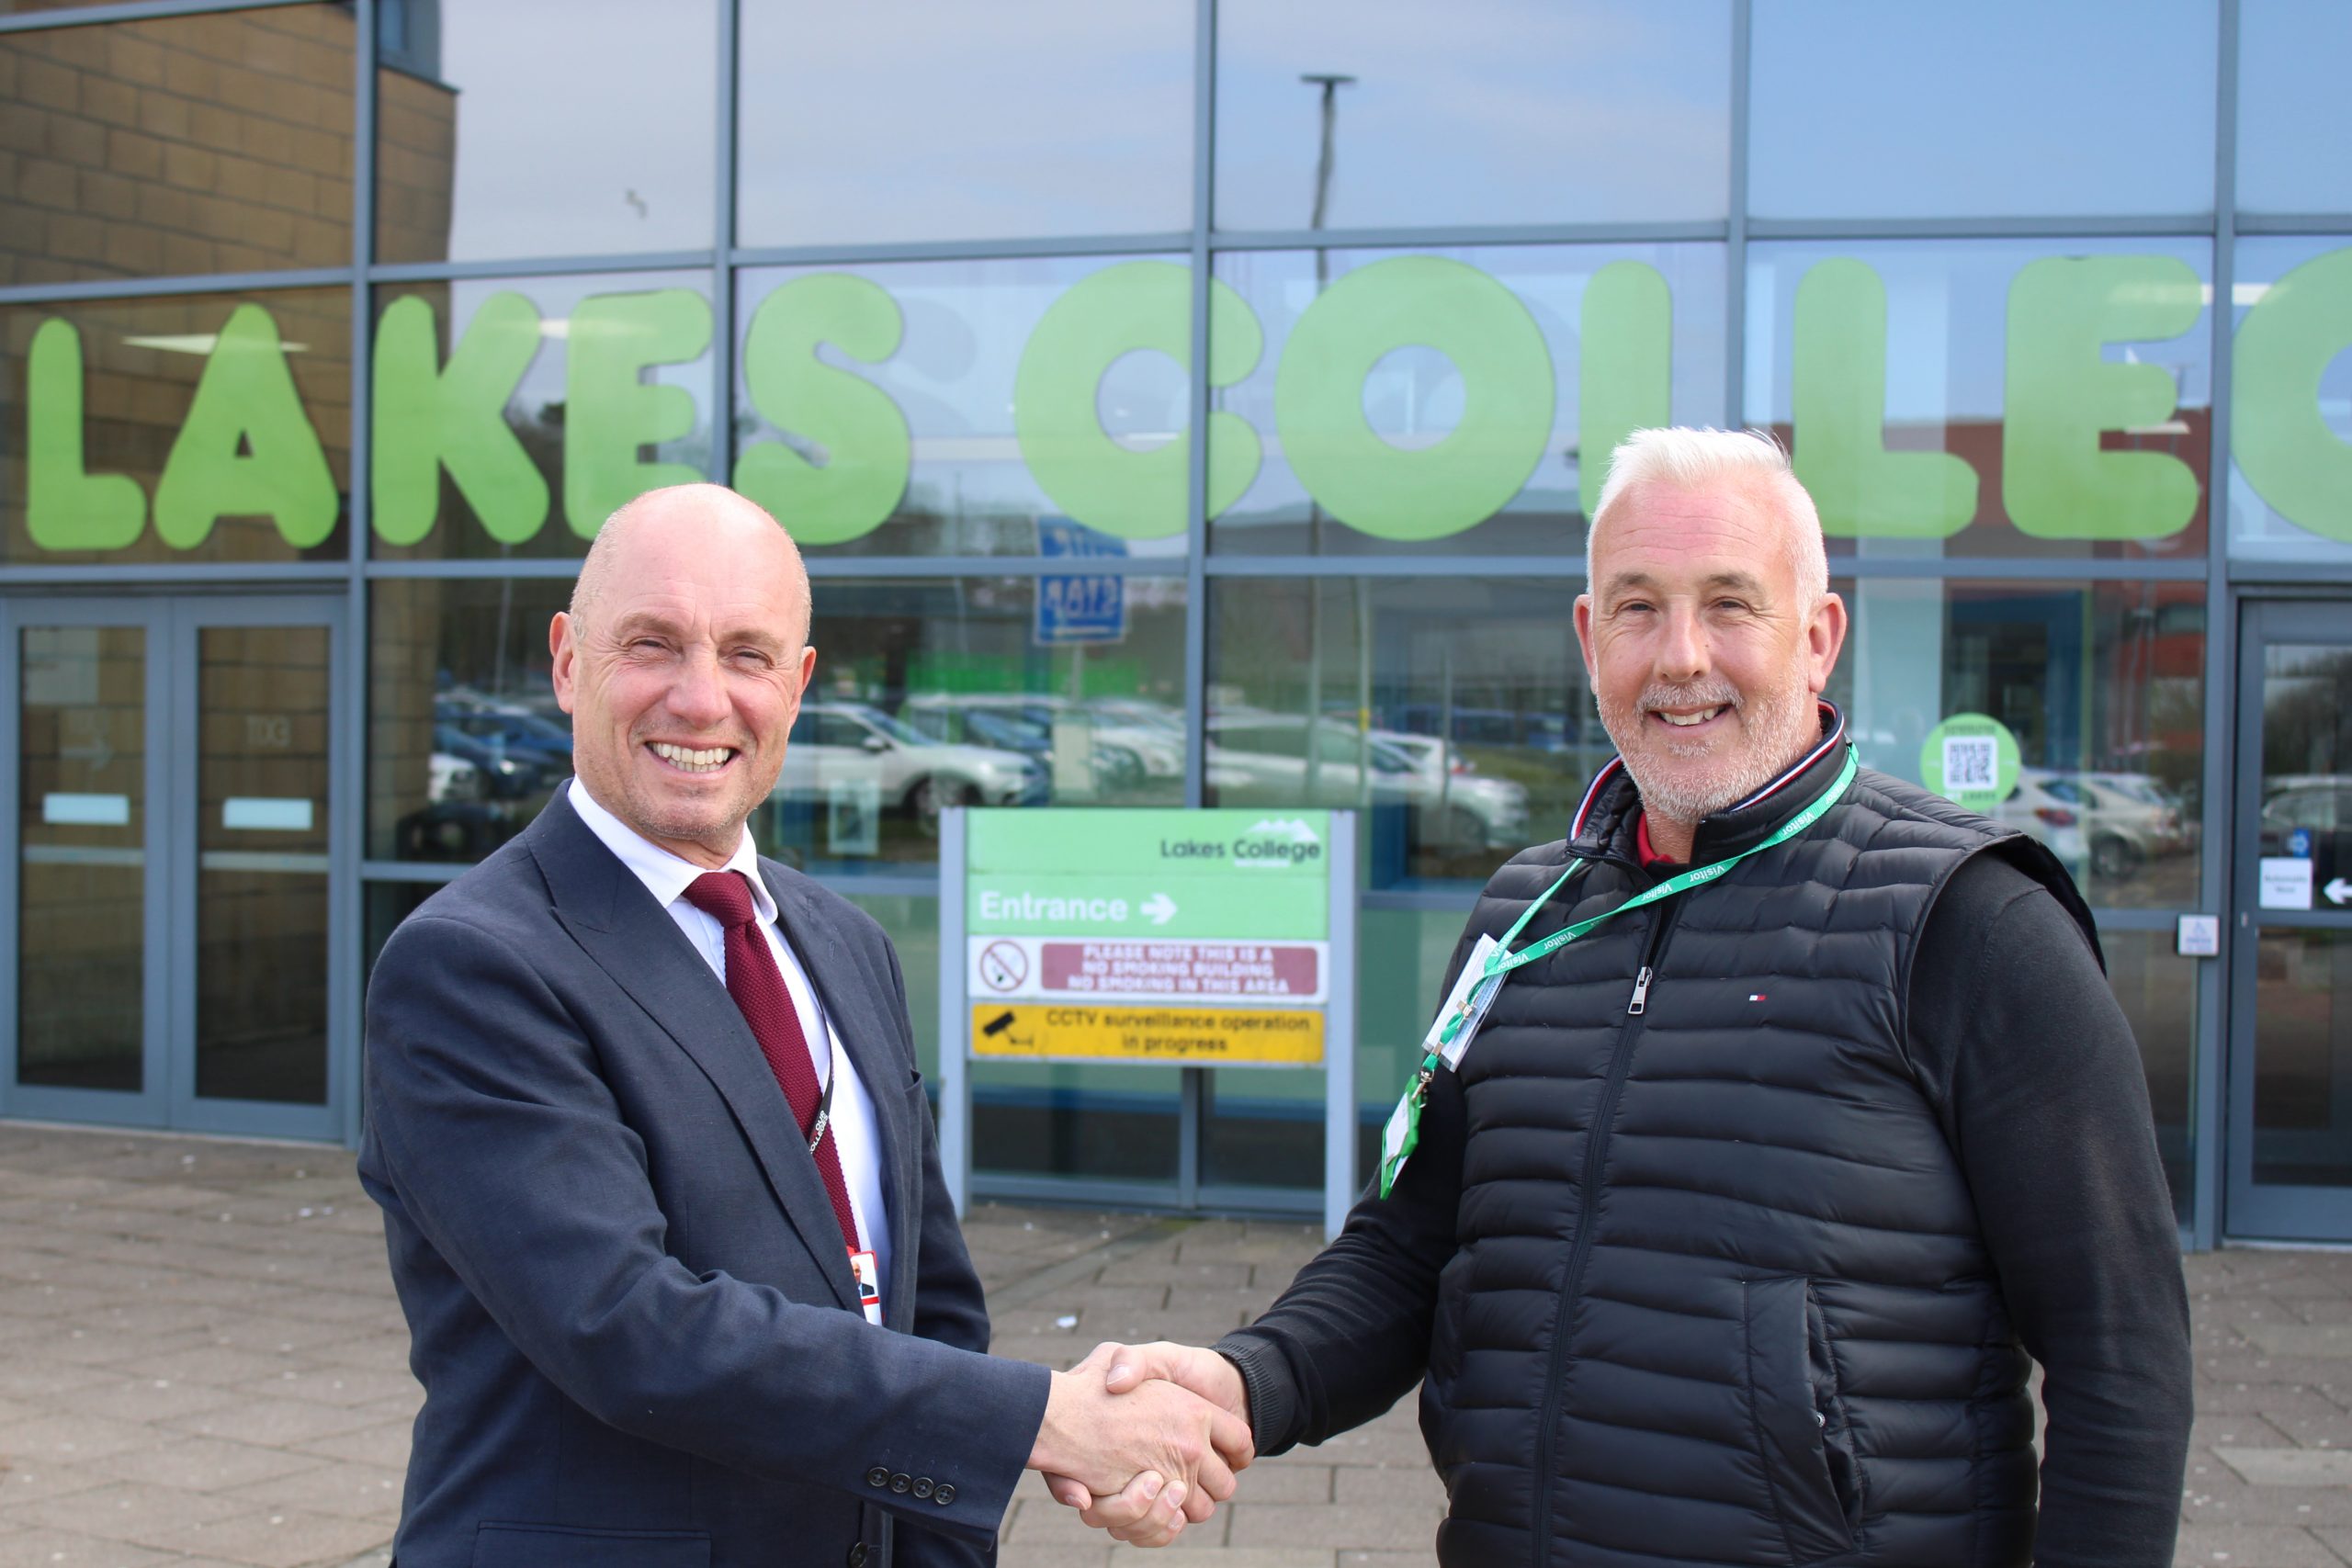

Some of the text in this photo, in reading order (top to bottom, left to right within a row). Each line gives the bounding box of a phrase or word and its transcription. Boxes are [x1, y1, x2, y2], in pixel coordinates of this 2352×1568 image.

[27, 273, 910, 549] LAKES
[1782, 811, 1815, 836] Visitor
[1161, 840, 1321, 864] Lakes College
[1690, 864, 1725, 883] Visitor
[1640, 883, 1673, 901] Visitor
[979, 891, 1128, 921] Entrance
[1544, 931, 1577, 950] Visitor
[1261, 947, 1273, 962] A
[1497, 953, 1529, 972] Visitor
[1082, 960, 1108, 975] NO
[1068, 975, 1093, 989] NO
[1244, 978, 1289, 993] AREA
[1046, 1010, 1310, 1032] CCTV surveillance operation
[1123, 1034, 1227, 1055] in progress
